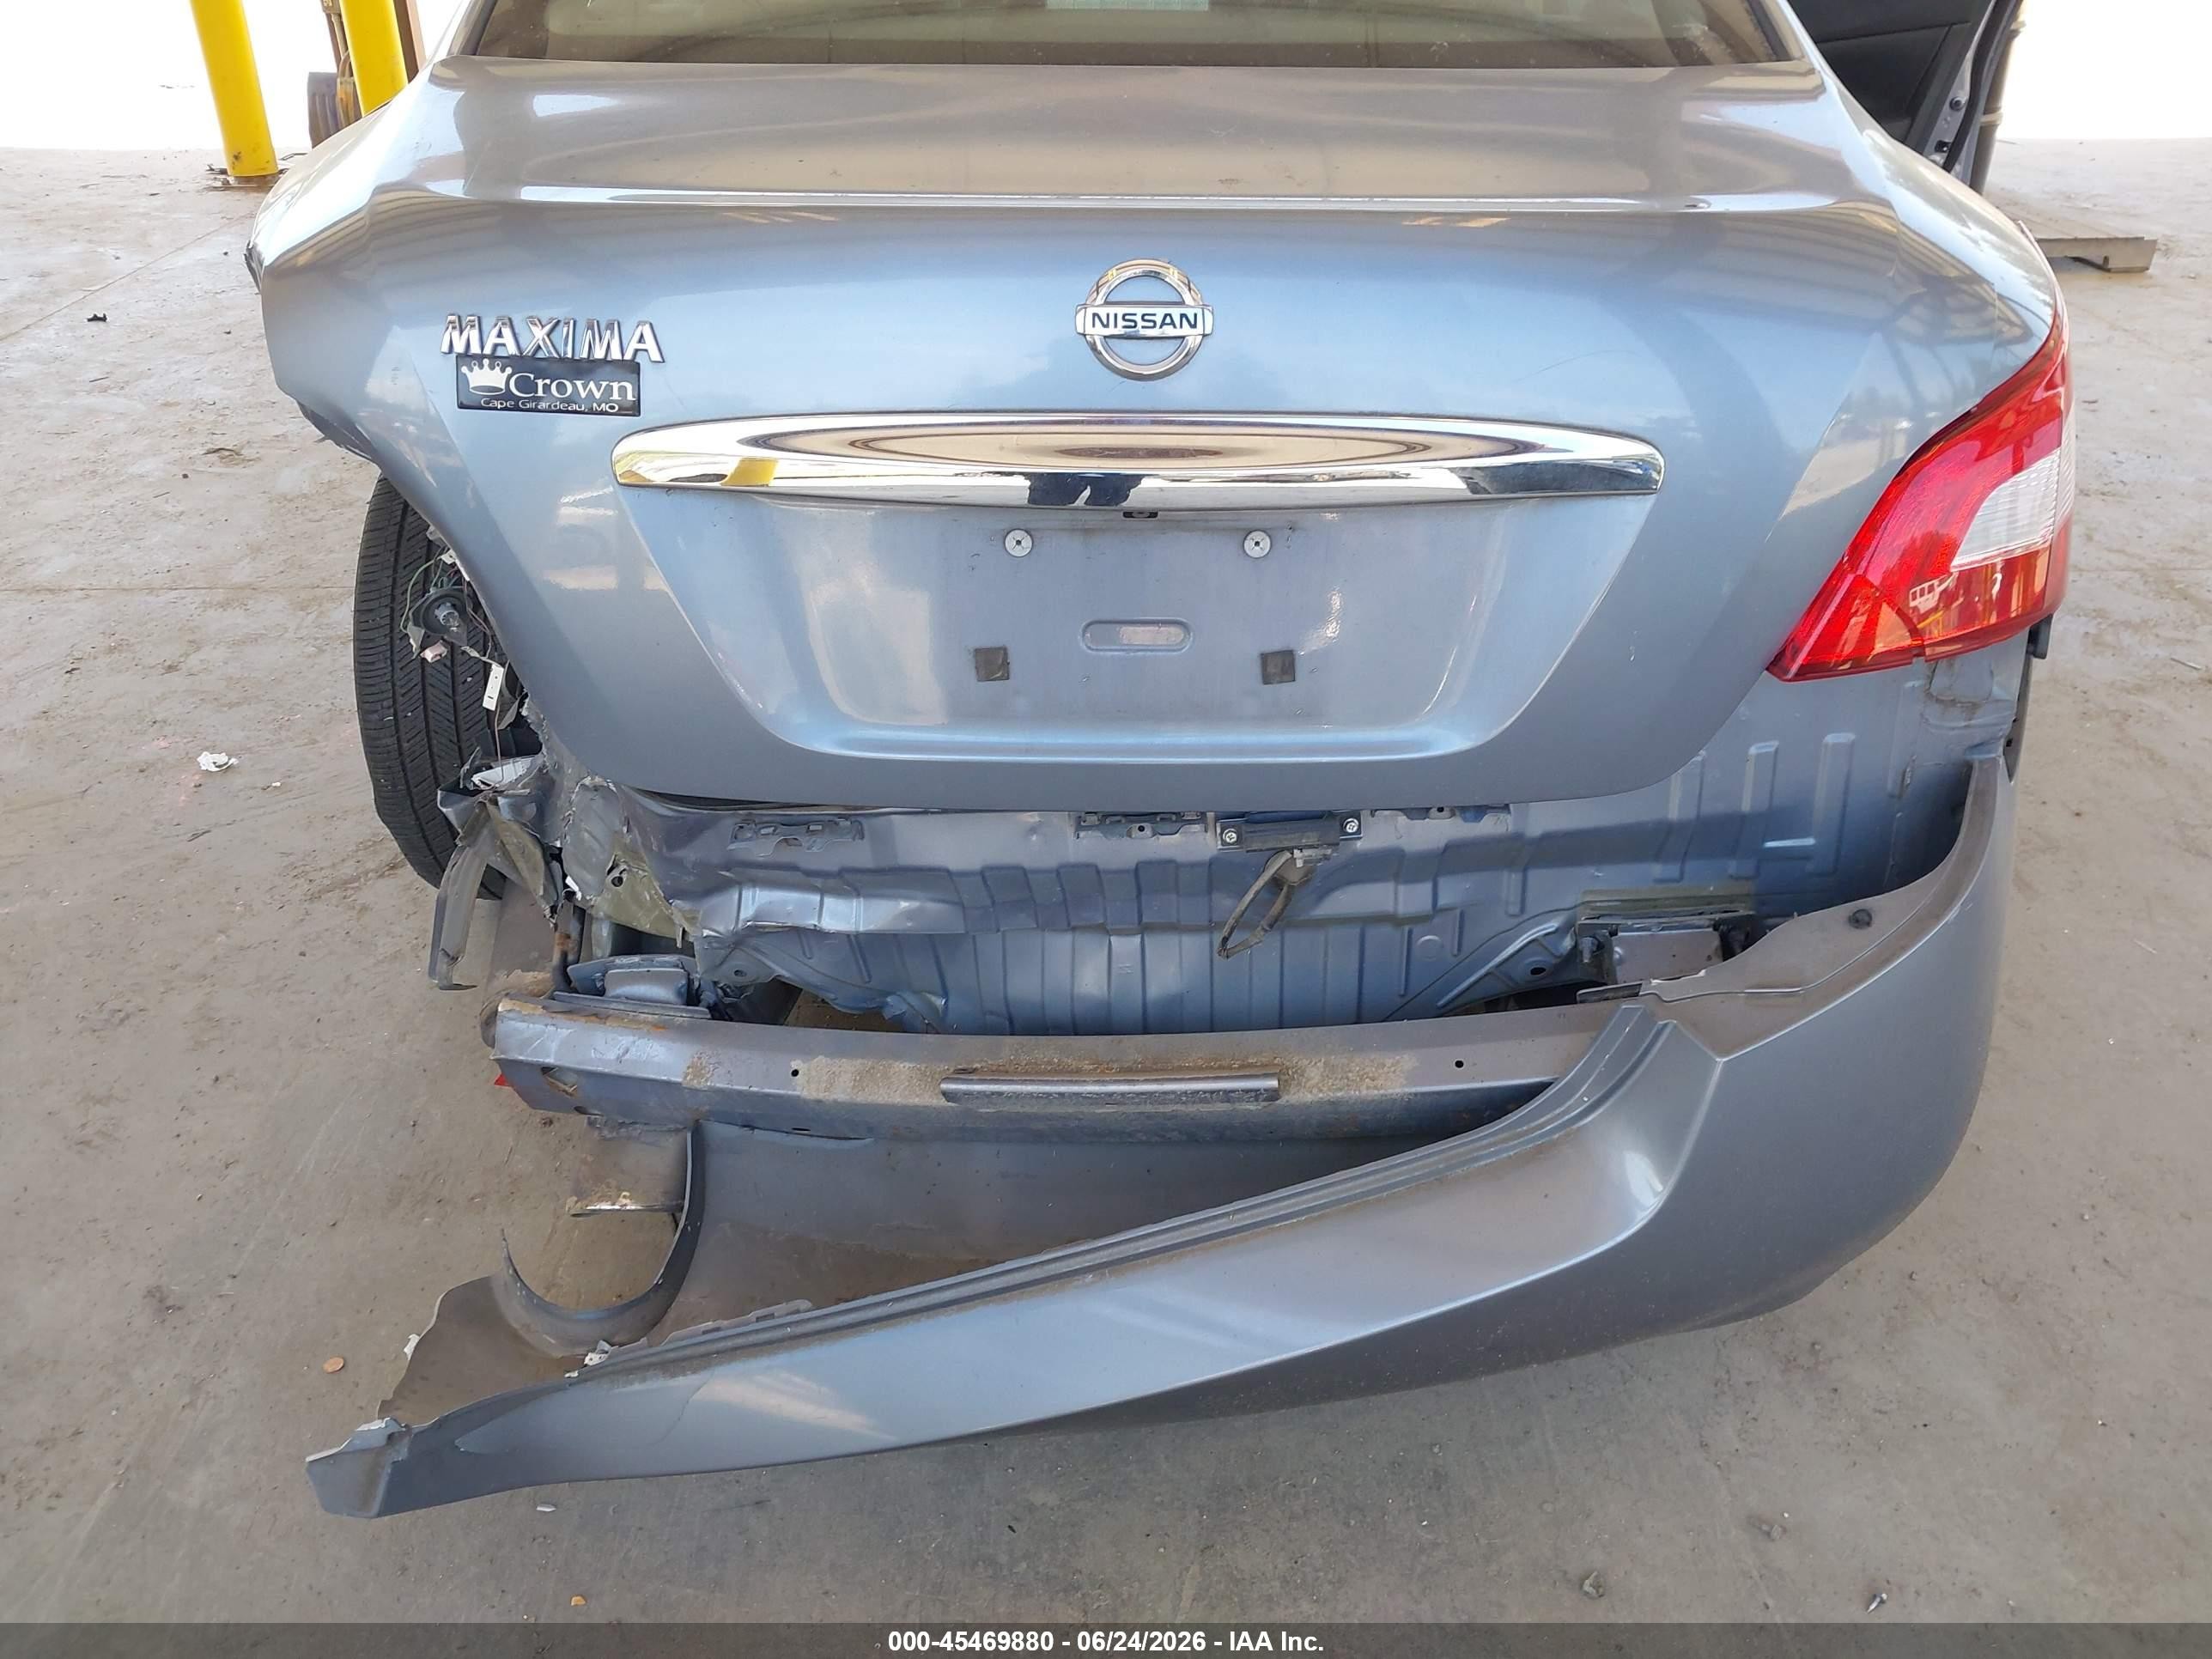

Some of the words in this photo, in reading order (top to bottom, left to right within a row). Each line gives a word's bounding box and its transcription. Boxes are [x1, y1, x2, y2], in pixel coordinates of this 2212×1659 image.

[1091, 313, 1198, 329] NISSAN
[441, 313, 665, 362] MAXIMA
[509, 373, 635, 400] Crown
[481, 398, 514, 410] Cape
[519, 399, 588, 412] Girardeau,
[592, 403, 618, 412] MO
